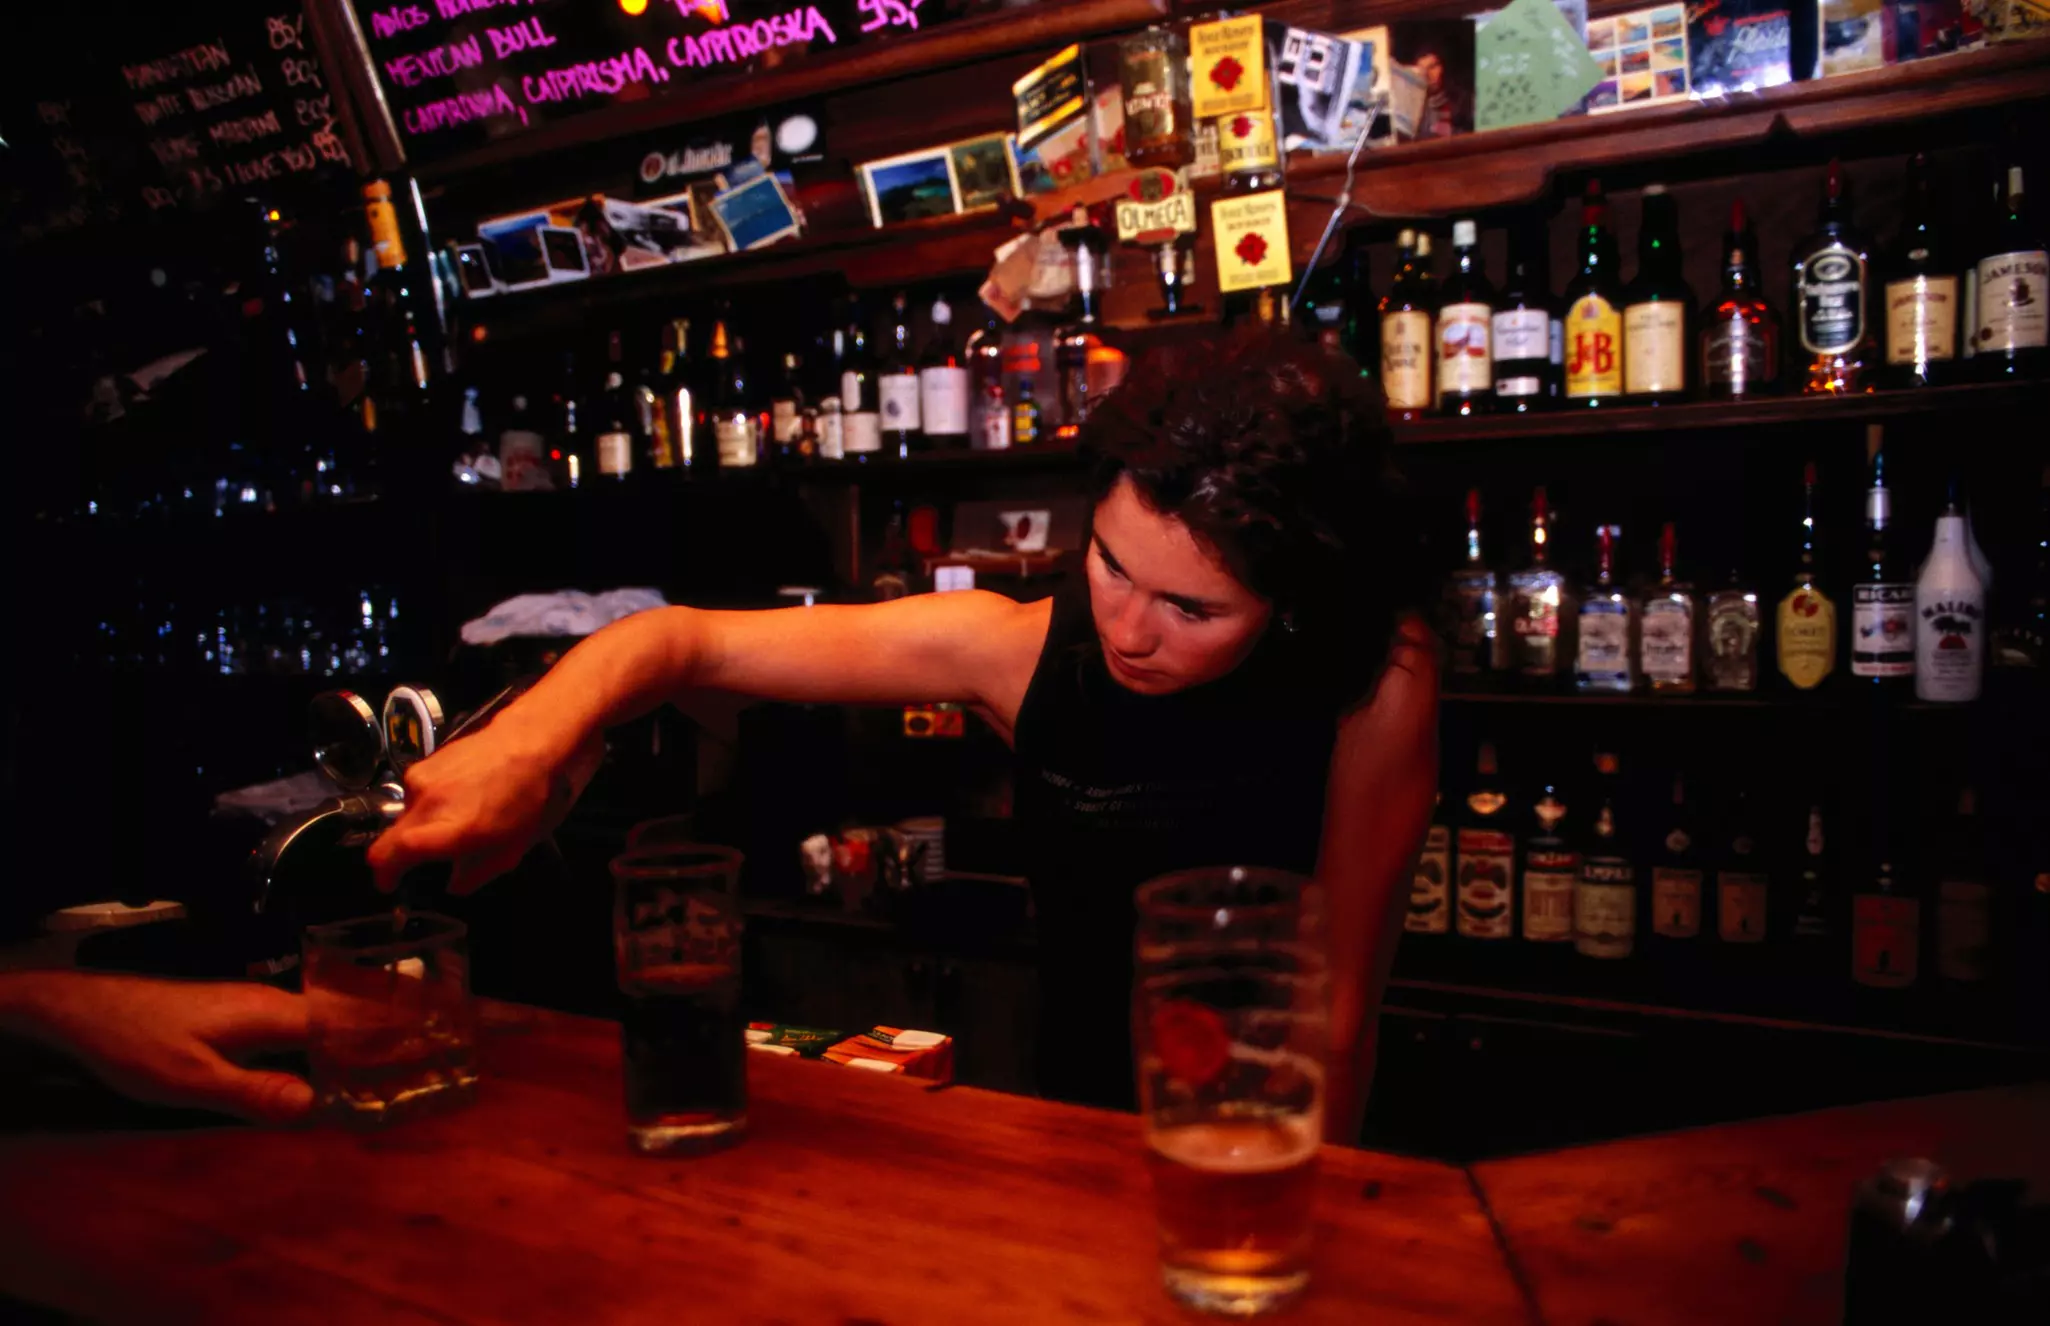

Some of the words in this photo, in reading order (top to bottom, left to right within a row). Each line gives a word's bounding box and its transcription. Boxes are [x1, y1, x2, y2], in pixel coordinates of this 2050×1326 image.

[385, 34, 483, 87] MEXICAN
[486, 16, 557, 59] BULL
[1120, 199, 1187, 232] OLMECA
